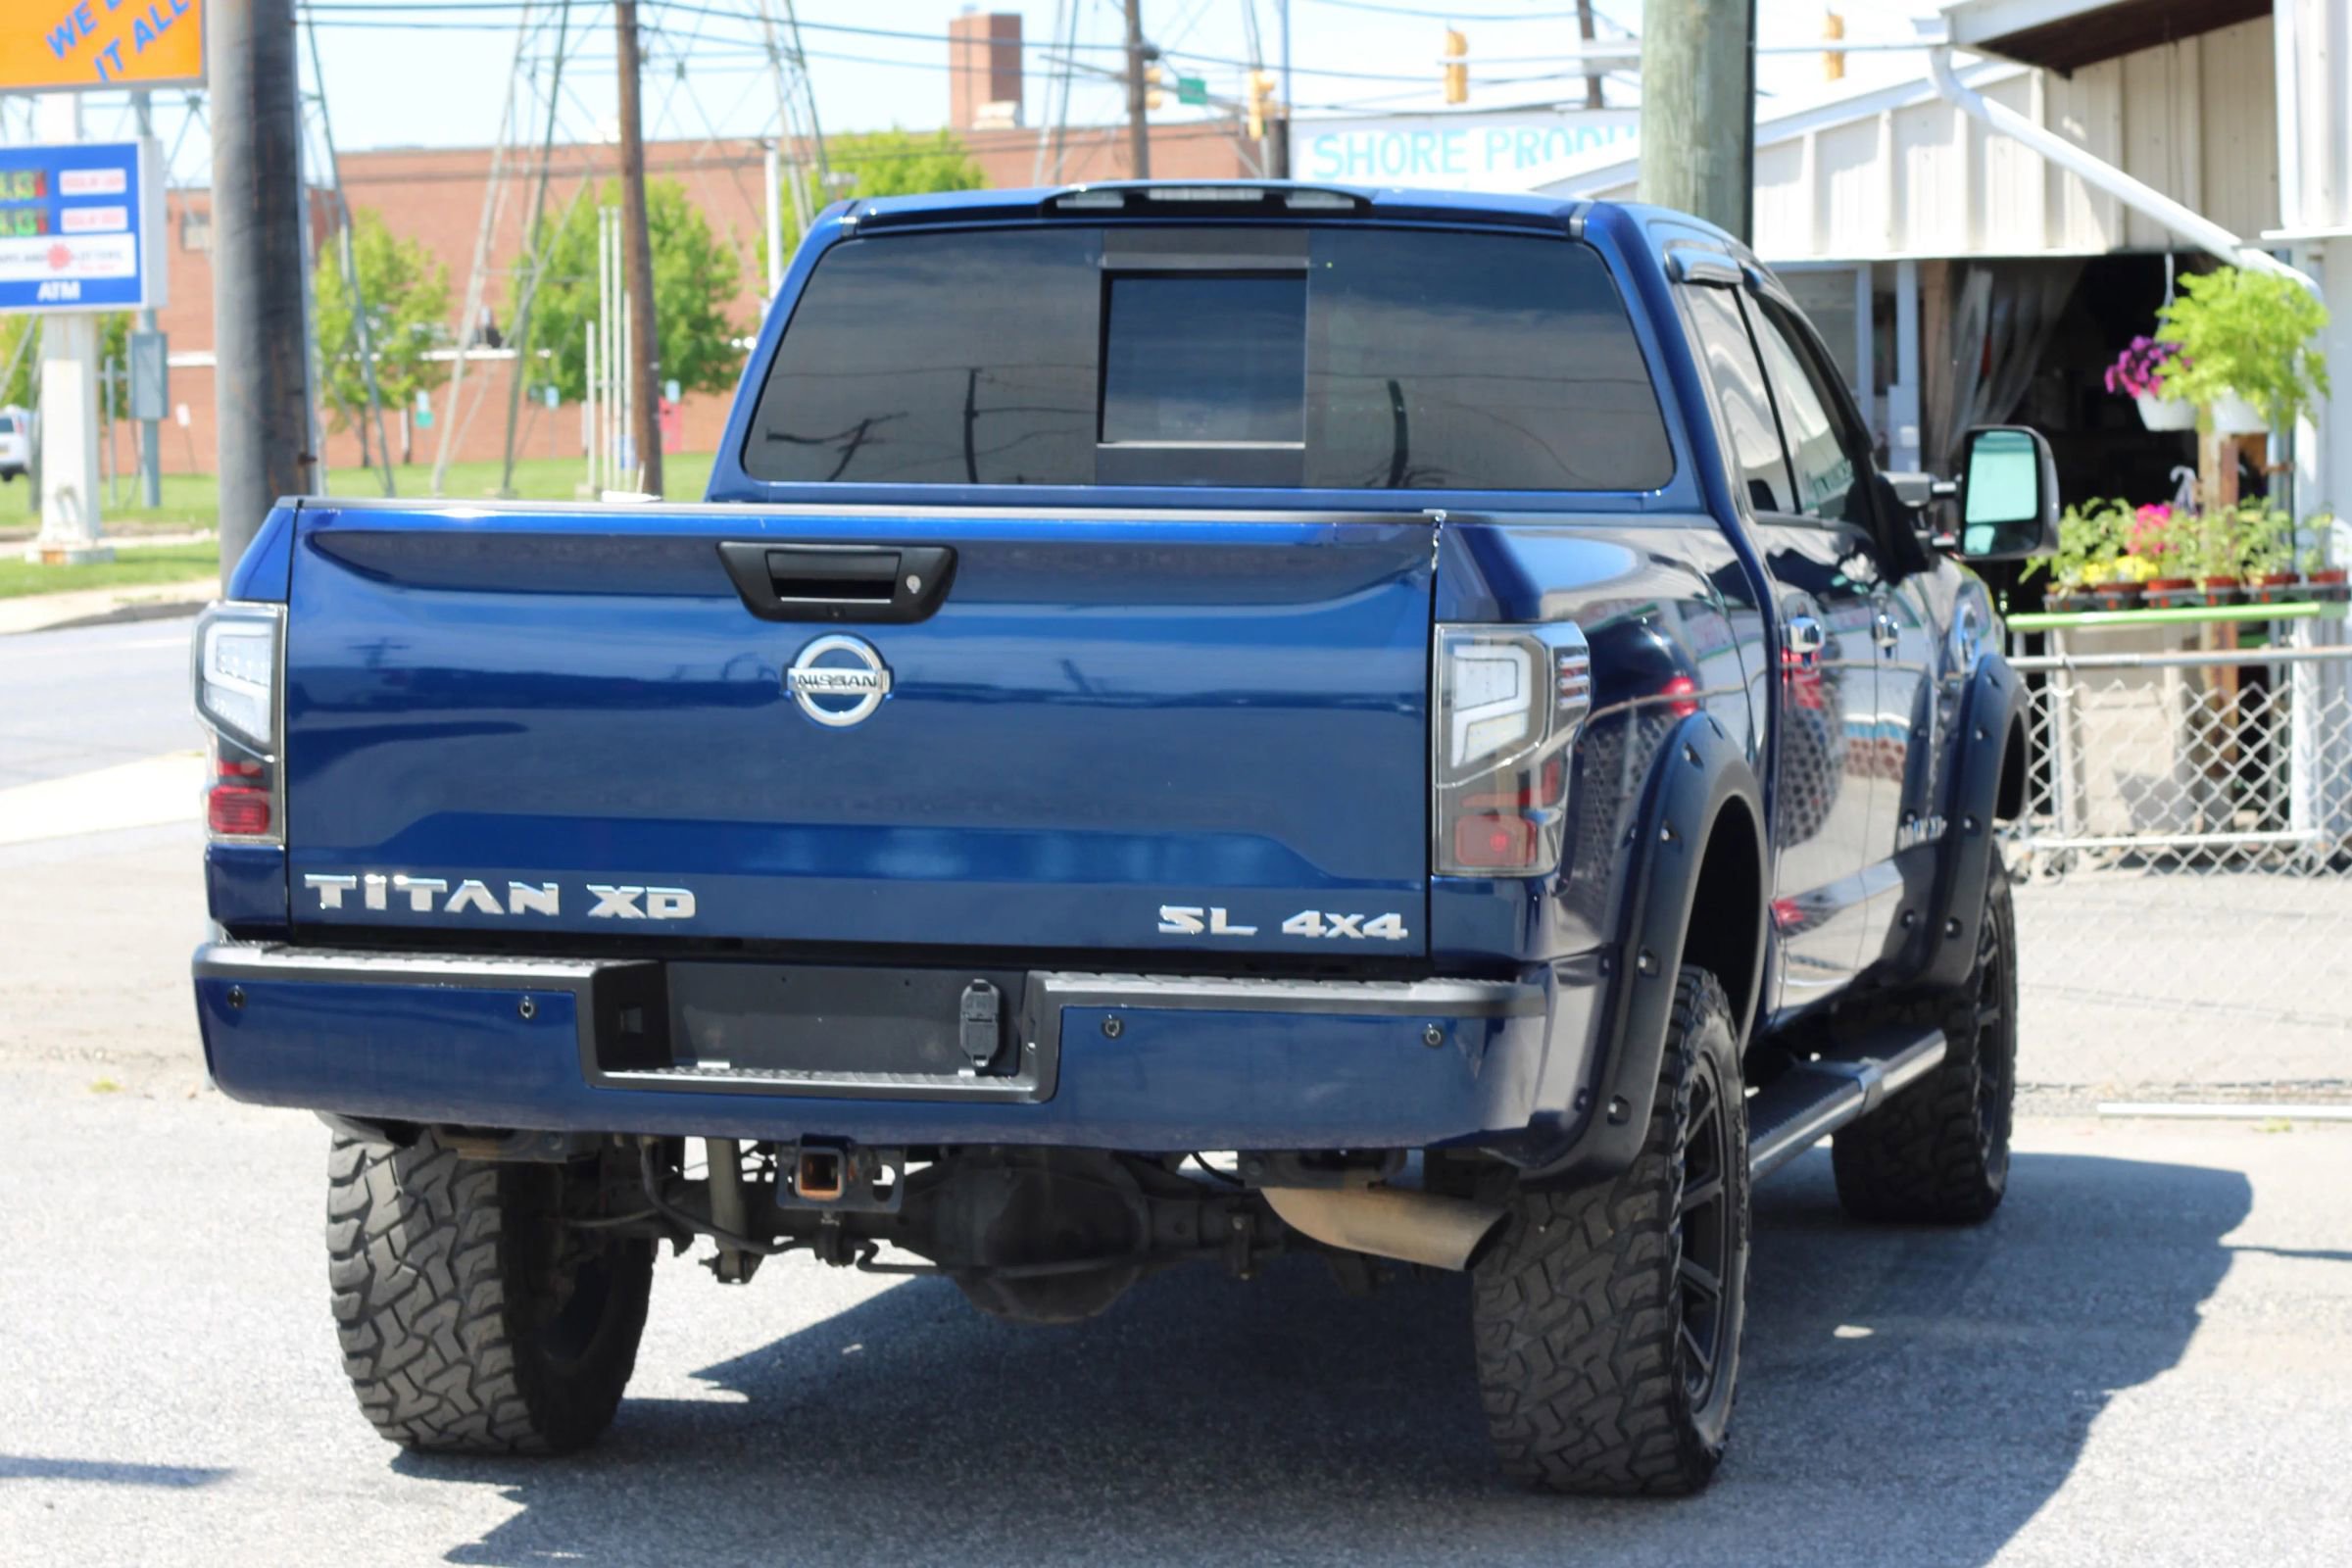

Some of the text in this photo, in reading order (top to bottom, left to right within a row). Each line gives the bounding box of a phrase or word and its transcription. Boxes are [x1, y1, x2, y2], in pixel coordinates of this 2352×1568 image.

[46, 0, 97, 59] WE
[94, 0, 190, 83] IT ALL
[1312, 124, 1636, 179] SHORE PROD
[36, 279, 81, 302] ATM
[797, 672, 879, 689] NISSAN
[305, 873, 697, 919] TITAN XD
[1157, 905, 1258, 936] SL
